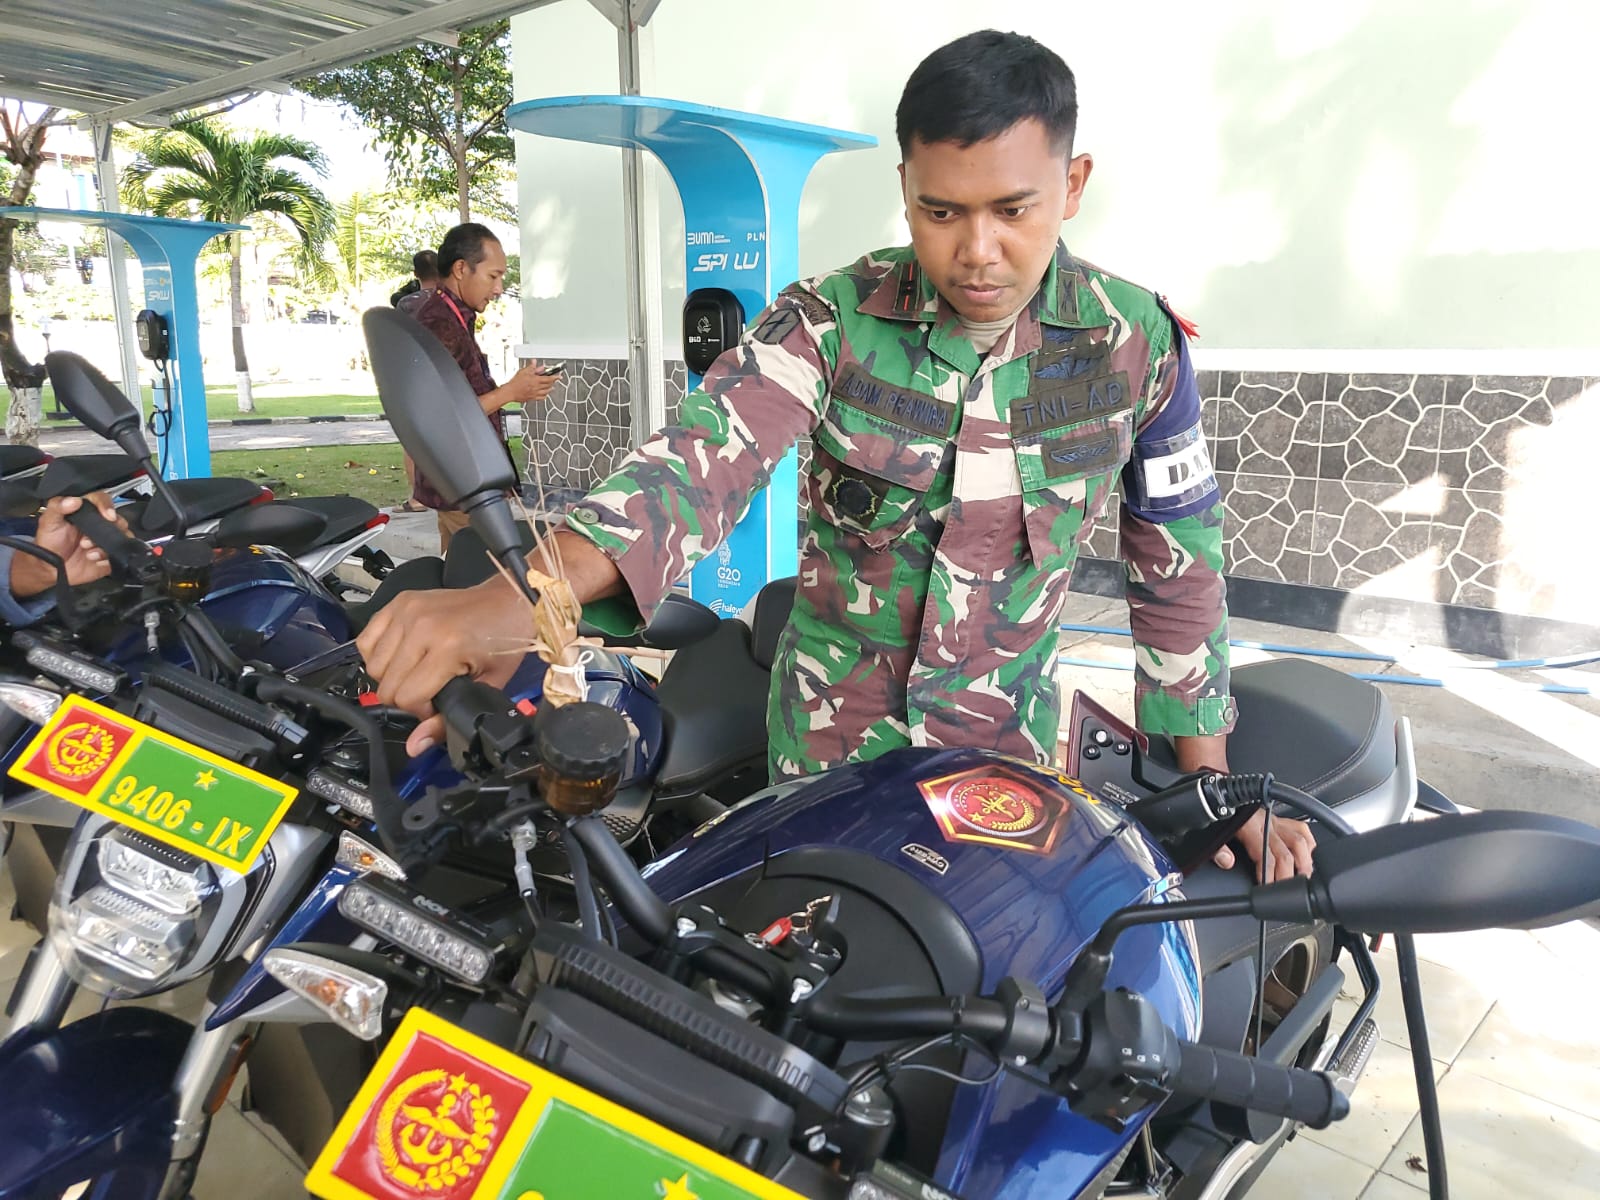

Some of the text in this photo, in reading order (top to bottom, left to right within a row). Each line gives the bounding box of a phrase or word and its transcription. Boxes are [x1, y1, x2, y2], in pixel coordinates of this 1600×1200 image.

[747, 232, 765, 241] PLN
[717, 566, 741, 582] G20
[109, 775, 192, 829] 9406
[207, 816, 251, 858] IX
